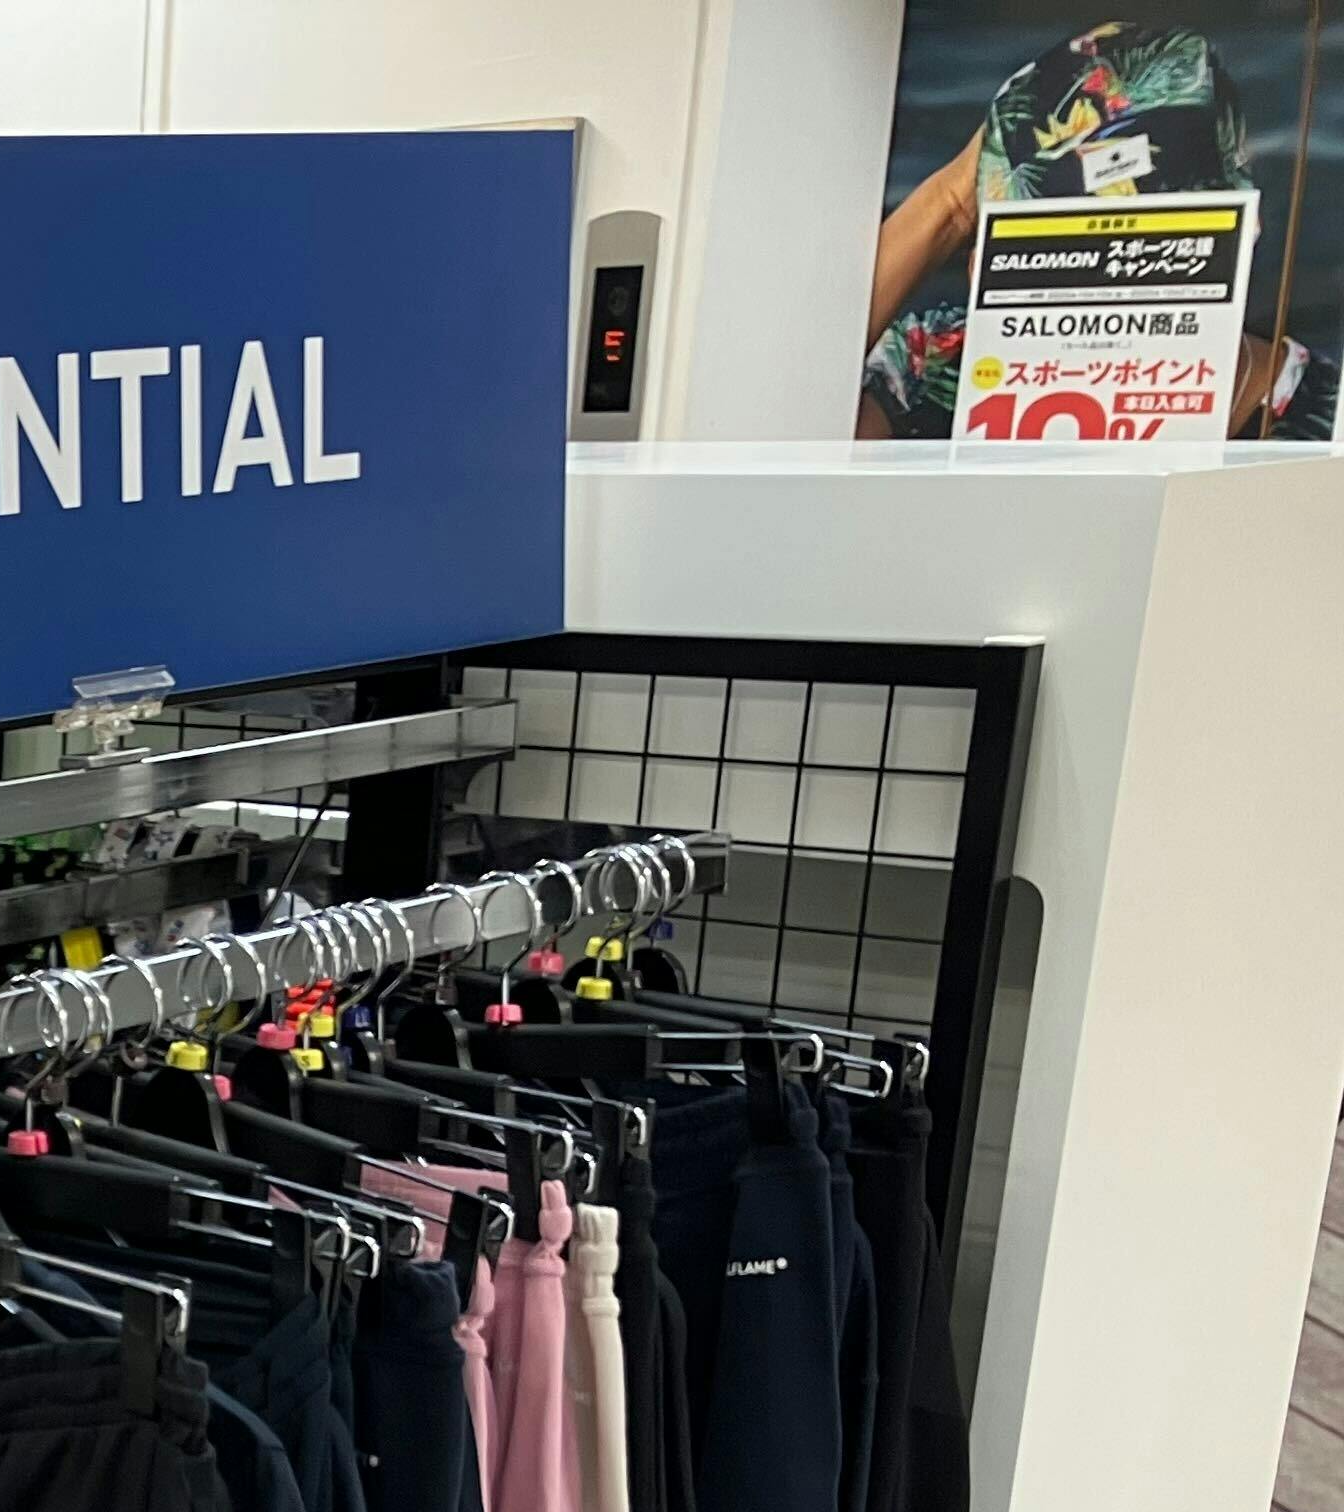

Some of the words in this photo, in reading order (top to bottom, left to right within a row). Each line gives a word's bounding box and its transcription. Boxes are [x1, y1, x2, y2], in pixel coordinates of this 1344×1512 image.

[990, 251, 1100, 272] SALOMON
[1104, 257, 1207, 279] キャンペーン
[1000, 311, 1200, 338] SALOMON商品
[1005, 355, 1217, 387] スポーツポイント
[1123, 393, 1205, 412] 本日入会可
